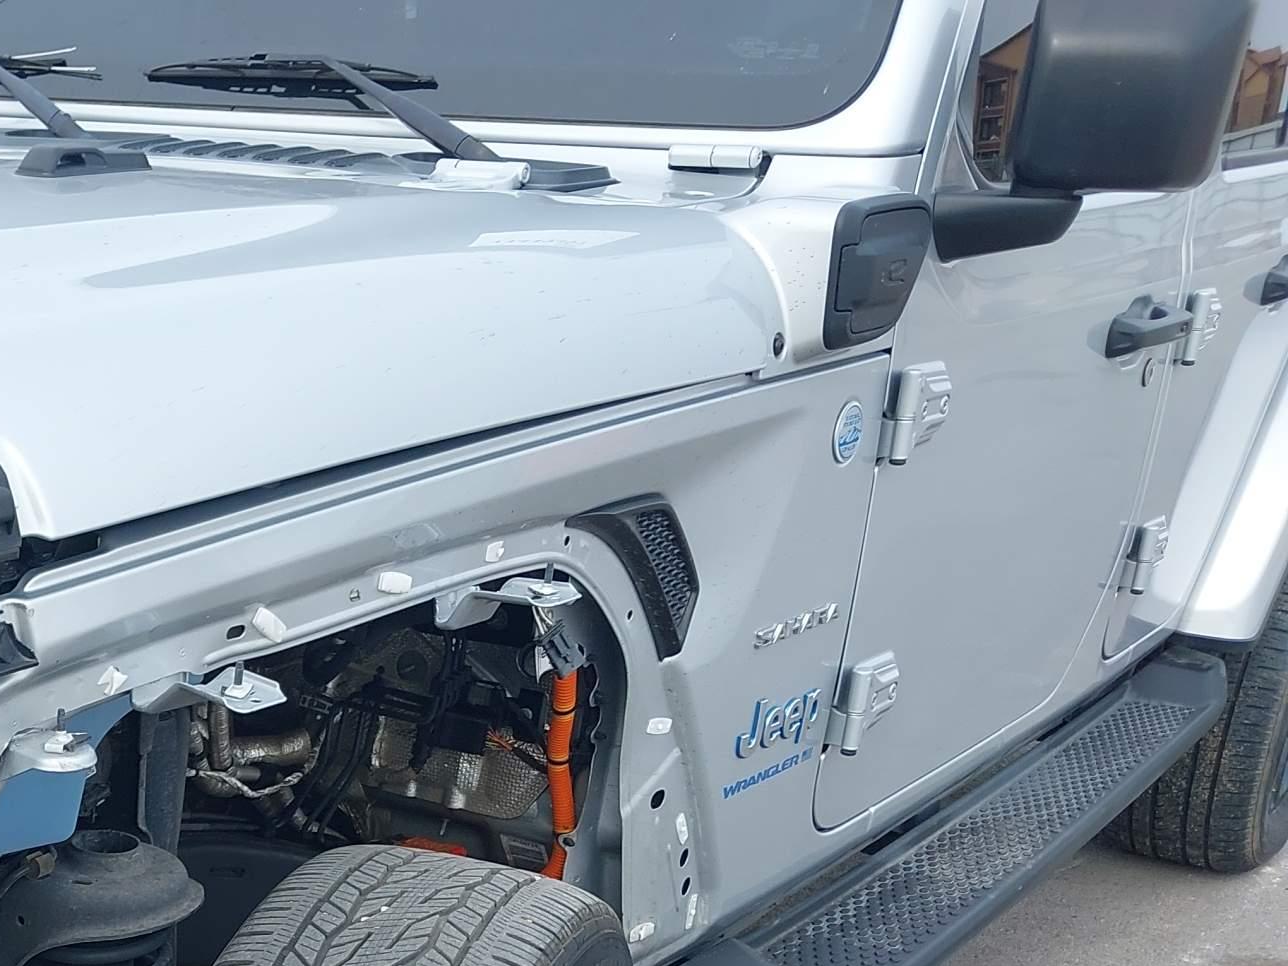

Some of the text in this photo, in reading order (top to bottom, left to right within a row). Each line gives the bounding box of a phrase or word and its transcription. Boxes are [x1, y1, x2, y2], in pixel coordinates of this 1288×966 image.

[753, 603, 839, 649] SAHARA
[735, 688, 822, 759] Jeep
[723, 754, 800, 799] WRANGLER
